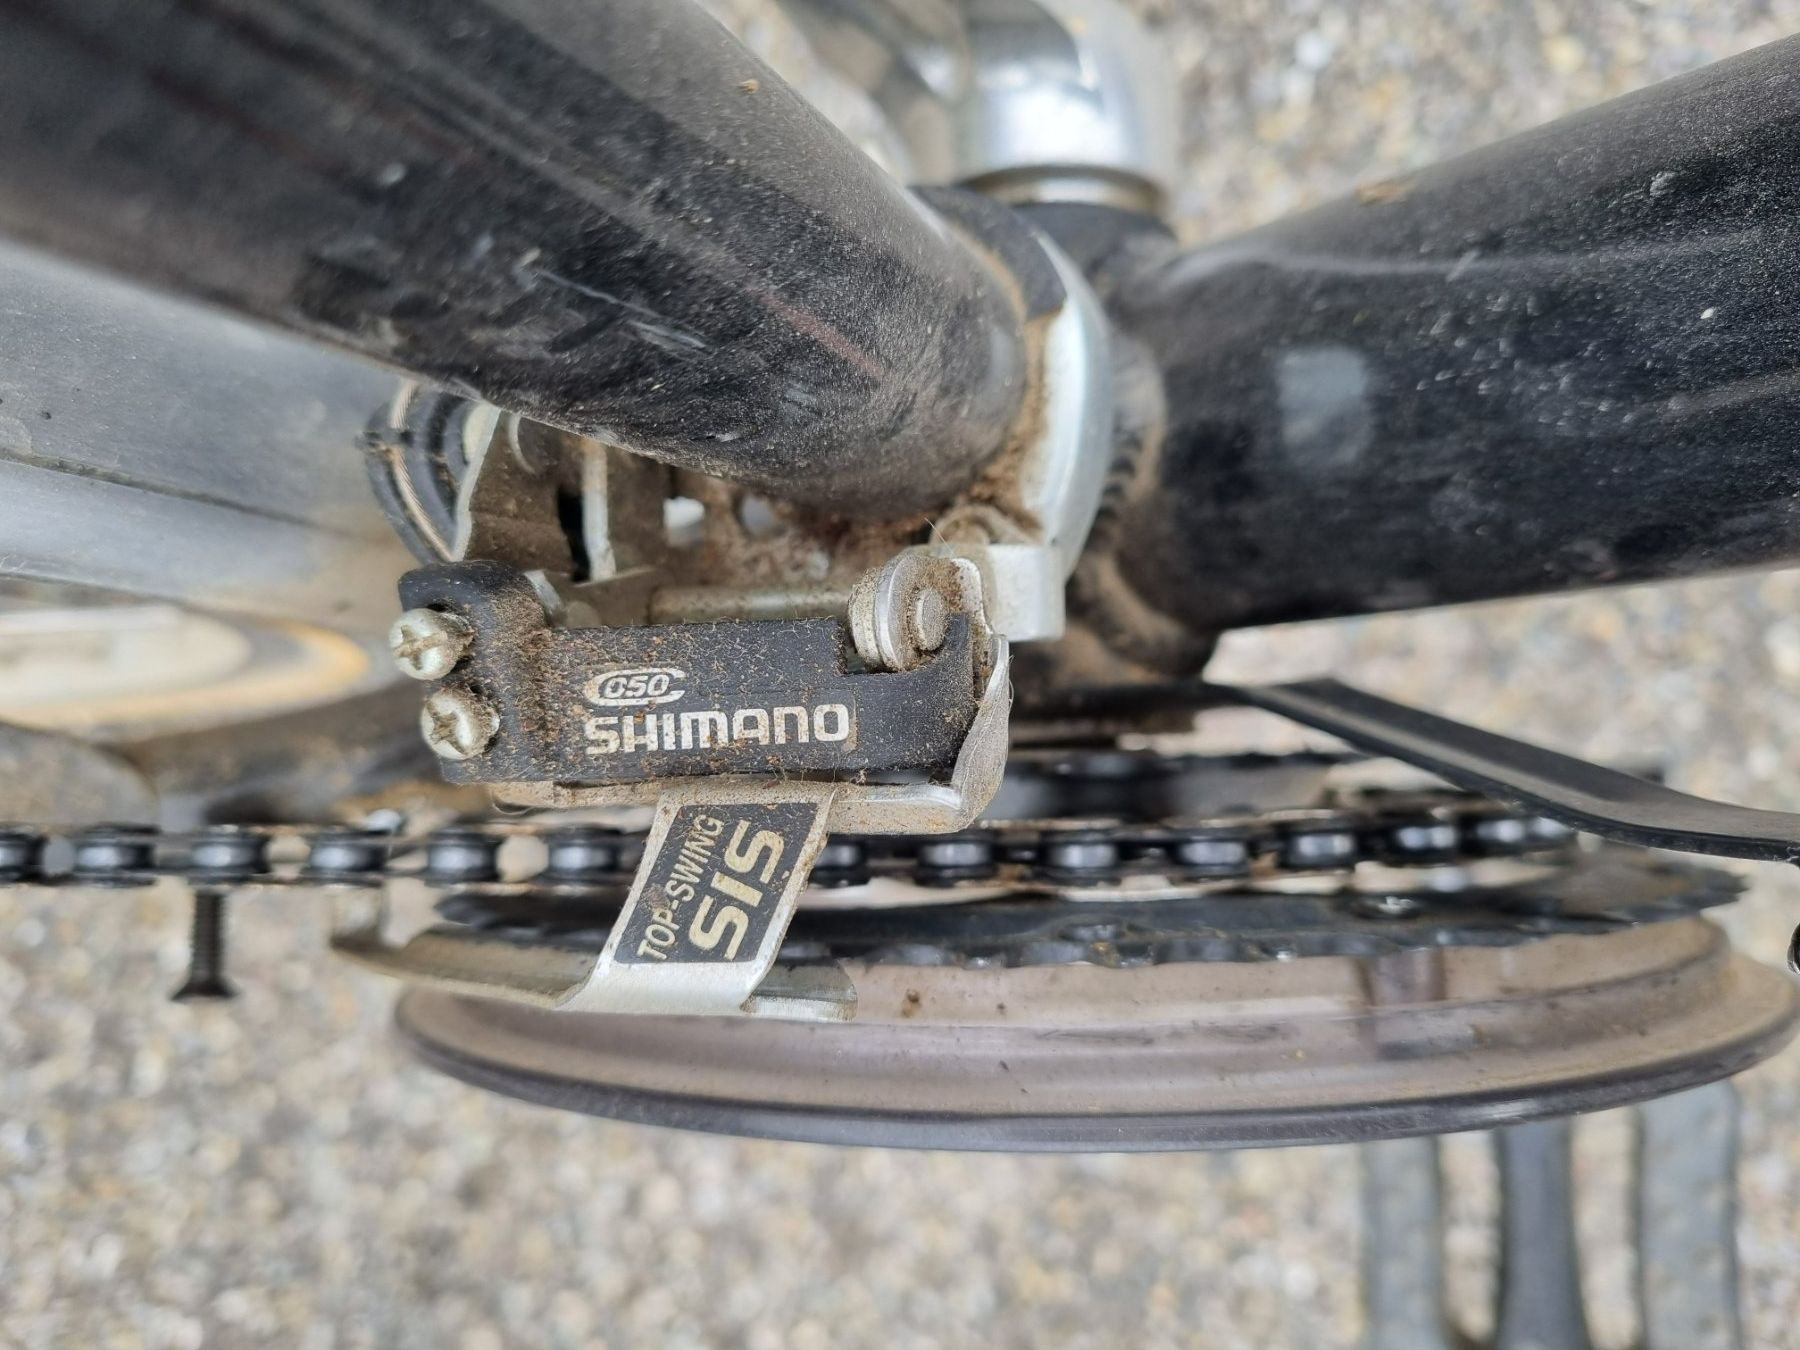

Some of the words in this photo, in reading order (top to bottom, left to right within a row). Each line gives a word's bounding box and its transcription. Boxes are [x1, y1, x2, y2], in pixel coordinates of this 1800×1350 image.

[585, 703, 850, 755] SHIMANO
[636, 814, 725, 960] TOP-SWING
[688, 818, 785, 961] SIS
